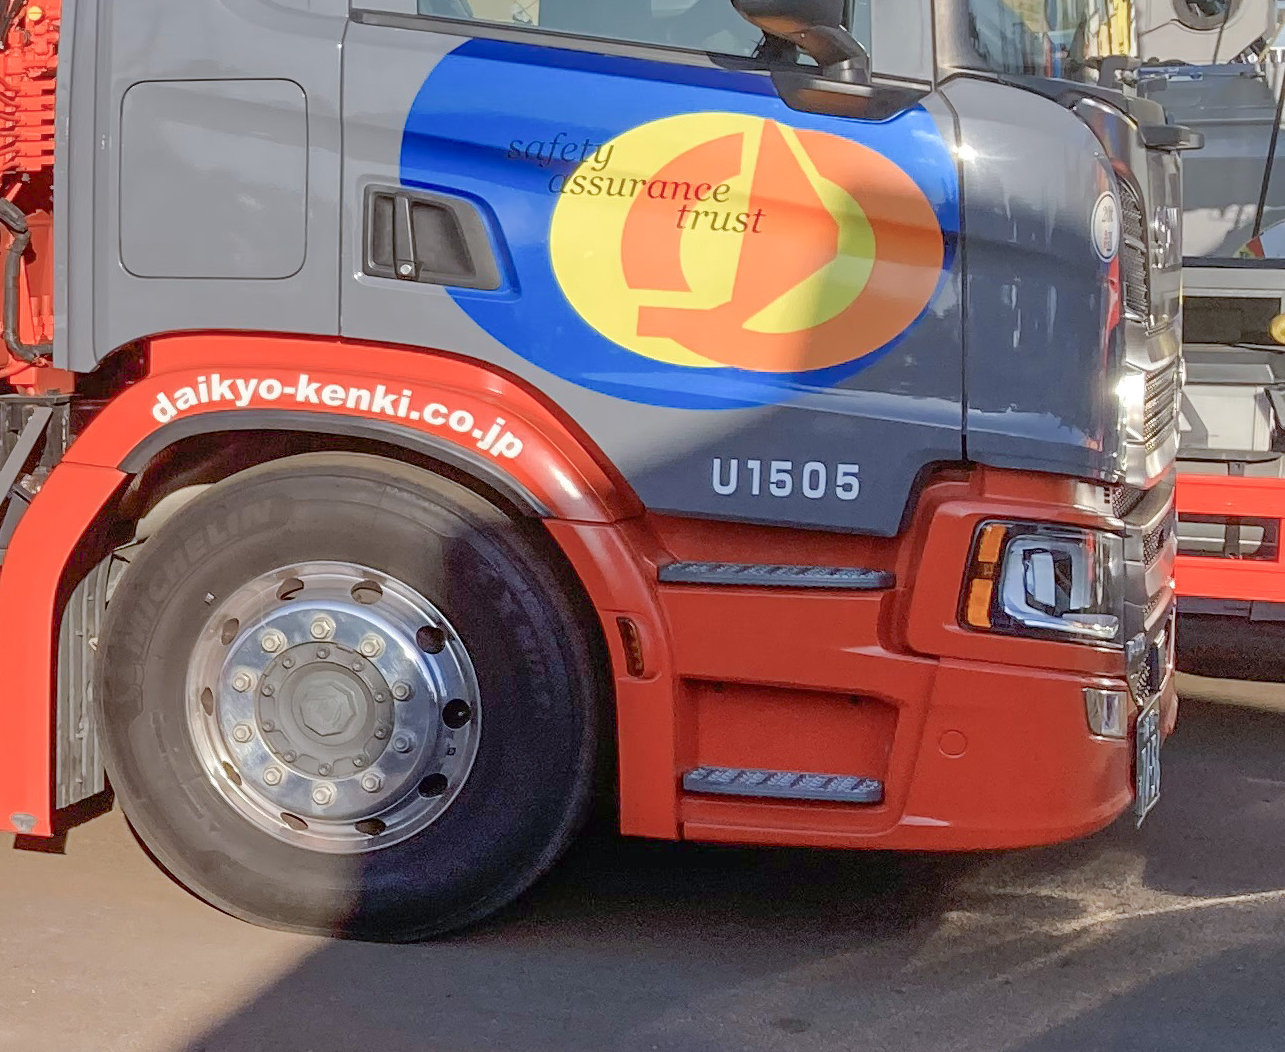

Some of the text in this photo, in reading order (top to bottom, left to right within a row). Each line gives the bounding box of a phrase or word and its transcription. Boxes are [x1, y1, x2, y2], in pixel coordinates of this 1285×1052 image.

[507, 132, 615, 172] safety
[547, 173, 731, 203] assurance
[675, 203, 767, 234] trust
[151, 373, 524, 460] daikyo-kenki.co.jp
[712, 457, 861, 501] U1505
